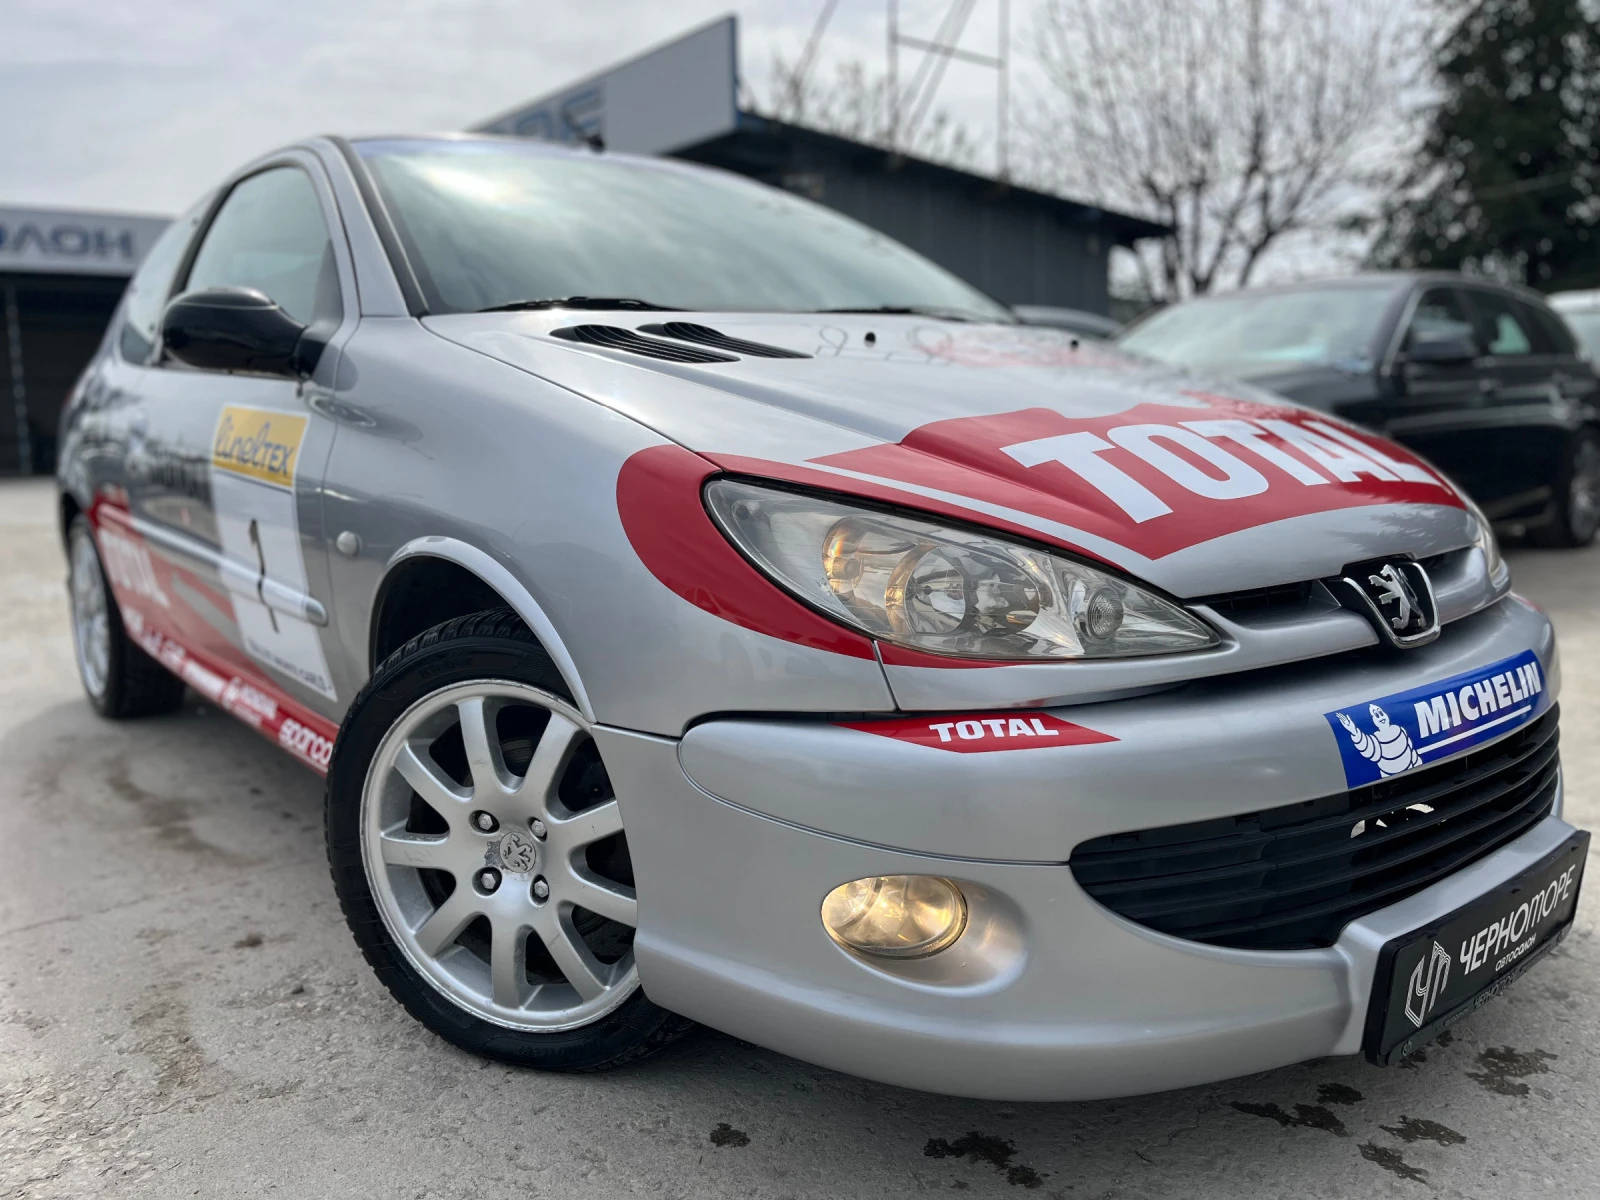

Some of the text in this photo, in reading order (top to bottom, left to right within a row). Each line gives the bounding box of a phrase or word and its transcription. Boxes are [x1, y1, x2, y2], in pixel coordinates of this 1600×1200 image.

[0, 221, 134, 261] ЛОН
[1001, 417, 1452, 525] TOTAL
[1413, 661, 1542, 739] MICHELIN
[929, 718, 1059, 743] TOTAL
